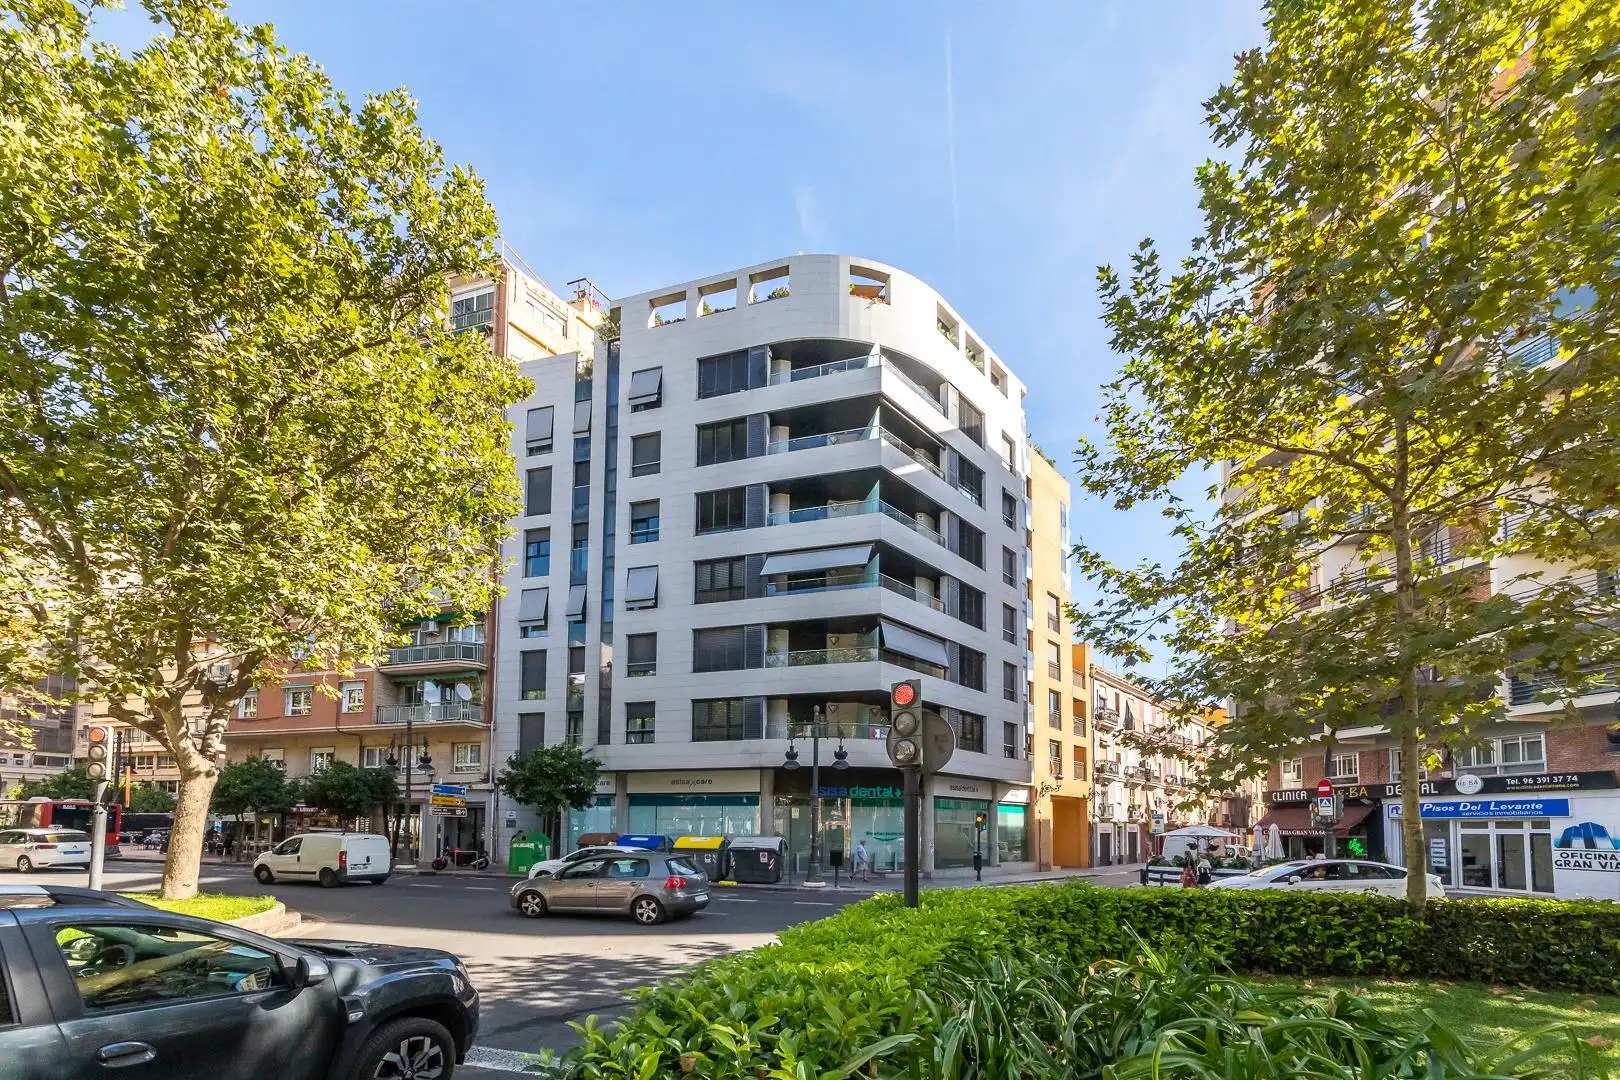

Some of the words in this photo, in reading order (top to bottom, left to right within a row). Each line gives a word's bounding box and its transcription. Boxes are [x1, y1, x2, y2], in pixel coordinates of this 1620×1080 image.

[1536, 776, 1550, 784] 391
[1553, 775, 1563, 783] 37
[849, 785, 893, 798] dental
[1385, 782, 1439, 796] DEAL
[1272, 790, 1307, 801] CLINICA
[1422, 803, 1455, 812] Pisos
[1459, 802, 1482, 811] Del
[1490, 801, 1544, 811] Levante
[1560, 851, 1619, 861] OFICINA
[1554, 859, 1593, 869] GRAN
